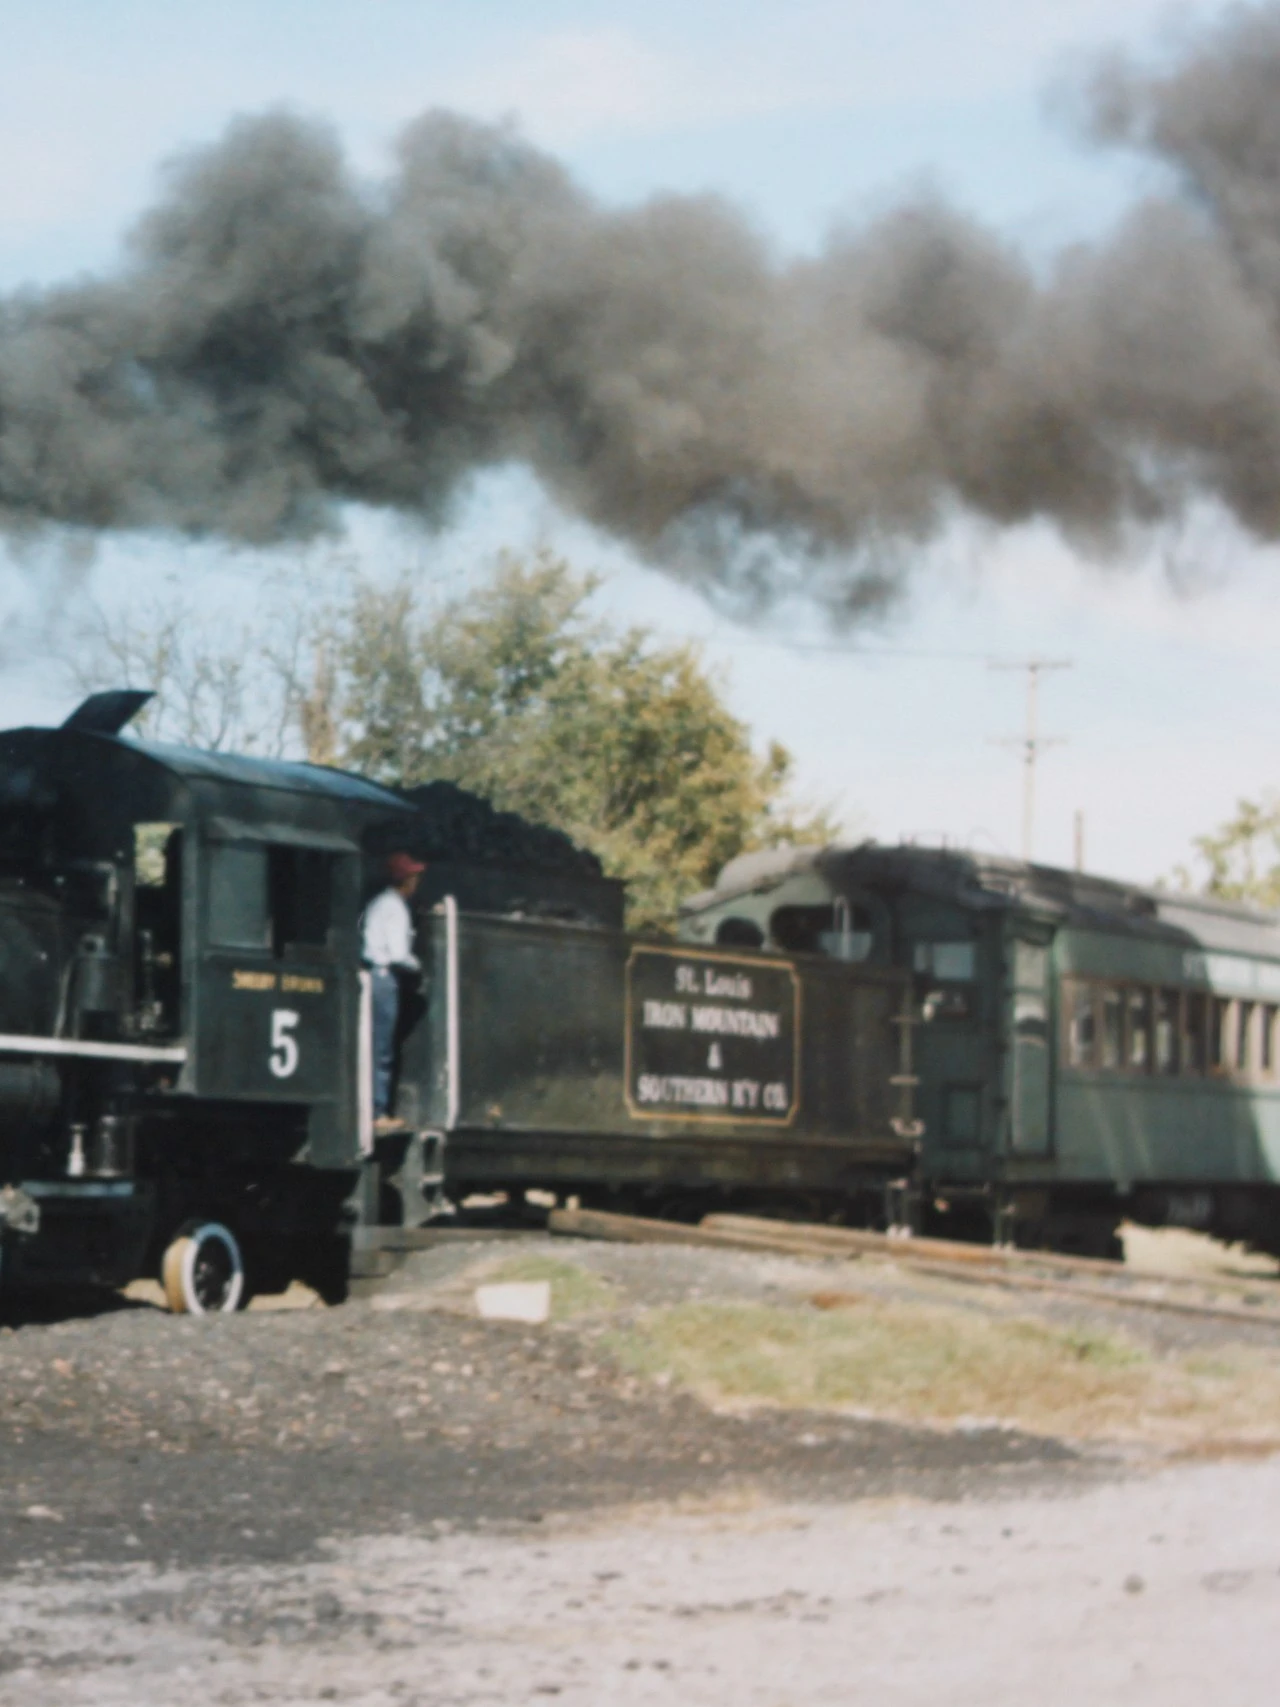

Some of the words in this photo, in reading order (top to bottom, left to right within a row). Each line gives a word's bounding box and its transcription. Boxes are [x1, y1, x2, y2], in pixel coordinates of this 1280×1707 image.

[705, 968, 752, 999] Louis
[643, 1000, 686, 1029] IRON
[691, 1005, 781, 1040] MOUNTAIN
[269, 1008, 299, 1078] 5
[637, 1073, 728, 1106] SOUTHERN
